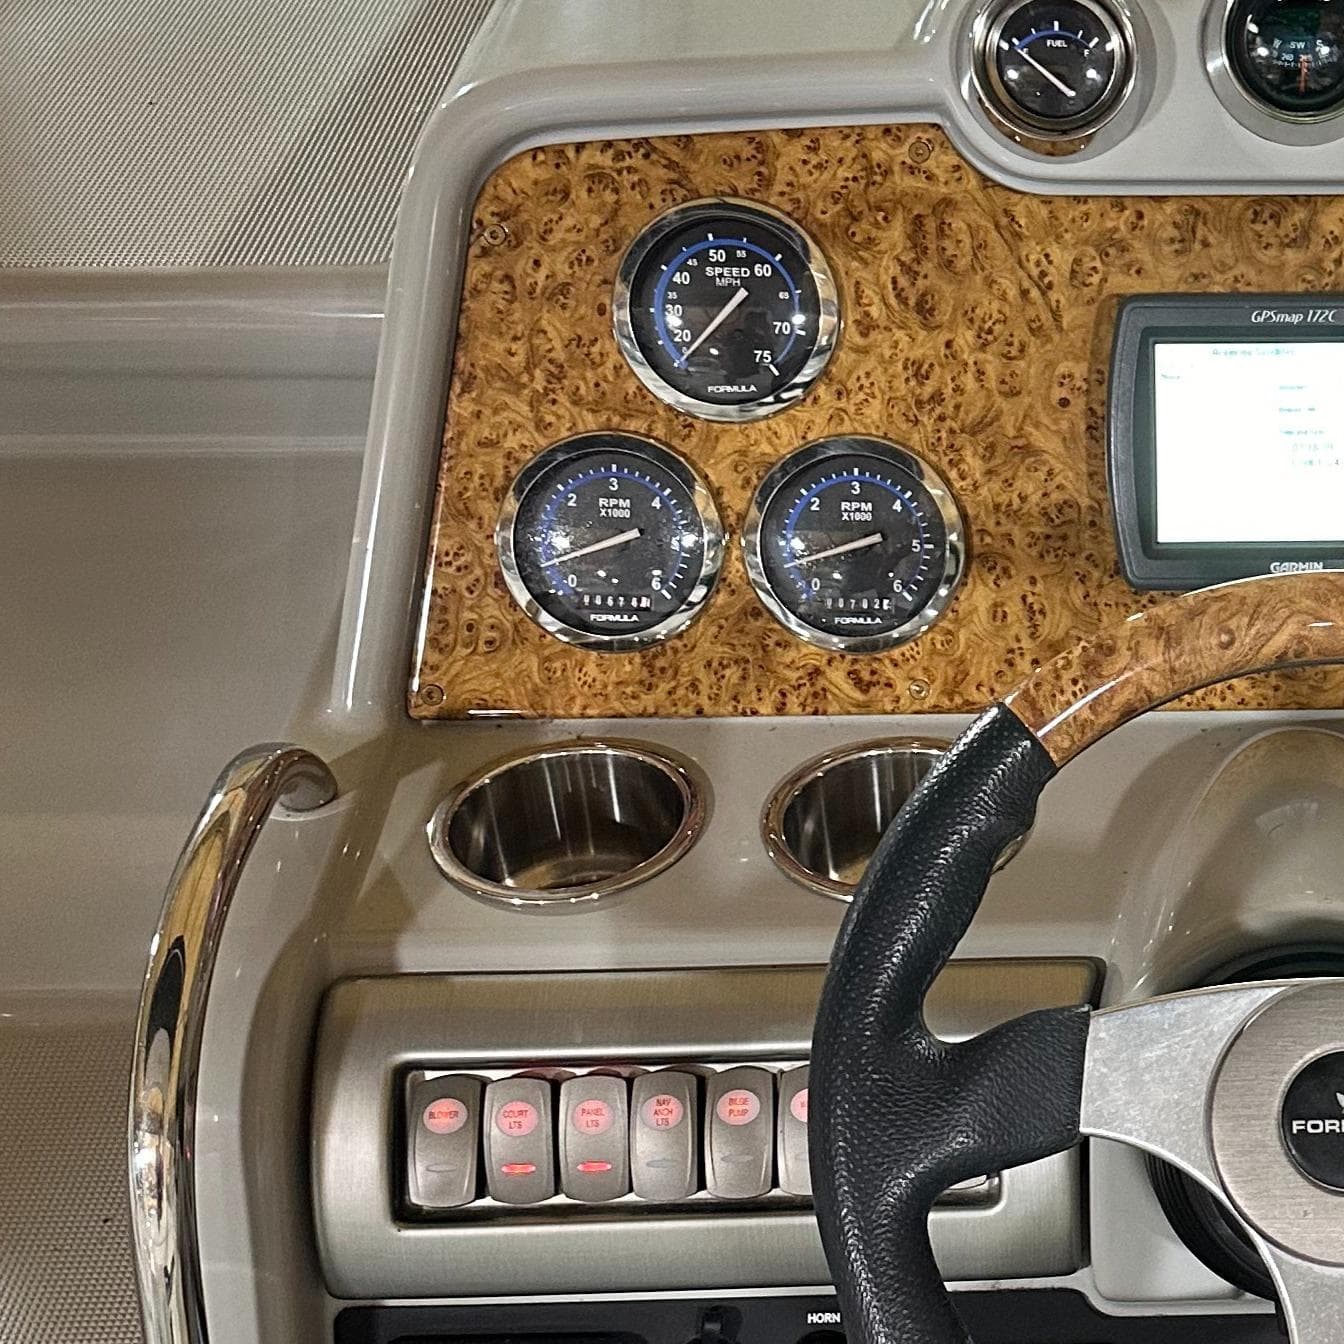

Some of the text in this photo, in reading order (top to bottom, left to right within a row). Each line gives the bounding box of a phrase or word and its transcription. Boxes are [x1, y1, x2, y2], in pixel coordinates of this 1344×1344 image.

[1046, 39, 1068, 48] FUEL
[708, 249, 726, 262] 50
[705, 267, 750, 277] SPEED
[754, 264, 772, 277] 60
[672, 272, 690, 284] 40
[715, 277, 741, 287] MPH
[665, 304, 682, 317] 30
[1251, 309, 1337, 325] GPSmap 172C
[773, 321, 791, 335] 70
[673, 329, 691, 342] 20
[754, 350, 772, 363] 75
[707, 385, 757, 393] FORMULA
[608, 478, 619, 491] 3
[851, 482, 861, 495] 3
[567, 493, 577, 506] 2
[599, 498, 631, 508] RPM
[652, 497, 662, 510] 4
[810, 497, 820, 511] 2
[841, 502, 872, 511] RPM
[892, 499, 902, 513] 4
[600, 508, 631, 518] X1000
[841, 512, 873, 521] X1000
[911, 540, 921, 552] 5
[1270, 561, 1323, 573] GARMIN
[568, 574, 577, 587] 0
[651, 577, 662, 590] 6
[811, 578, 821, 591] 0
[893, 579, 903, 593] 6
[590, 613, 640, 622] FORMULA
[834, 616, 883, 625] FORMULA
[656, 1098, 672, 1107] NAV
[428, 1110, 459, 1120] BLOWER
[503, 1109, 529, 1119] COURT
[508, 1120, 523, 1130] LTS
[586, 1119, 600, 1128] LTS
[655, 1118, 670, 1127] LTS
[807, 1312, 841, 1324] HORN
